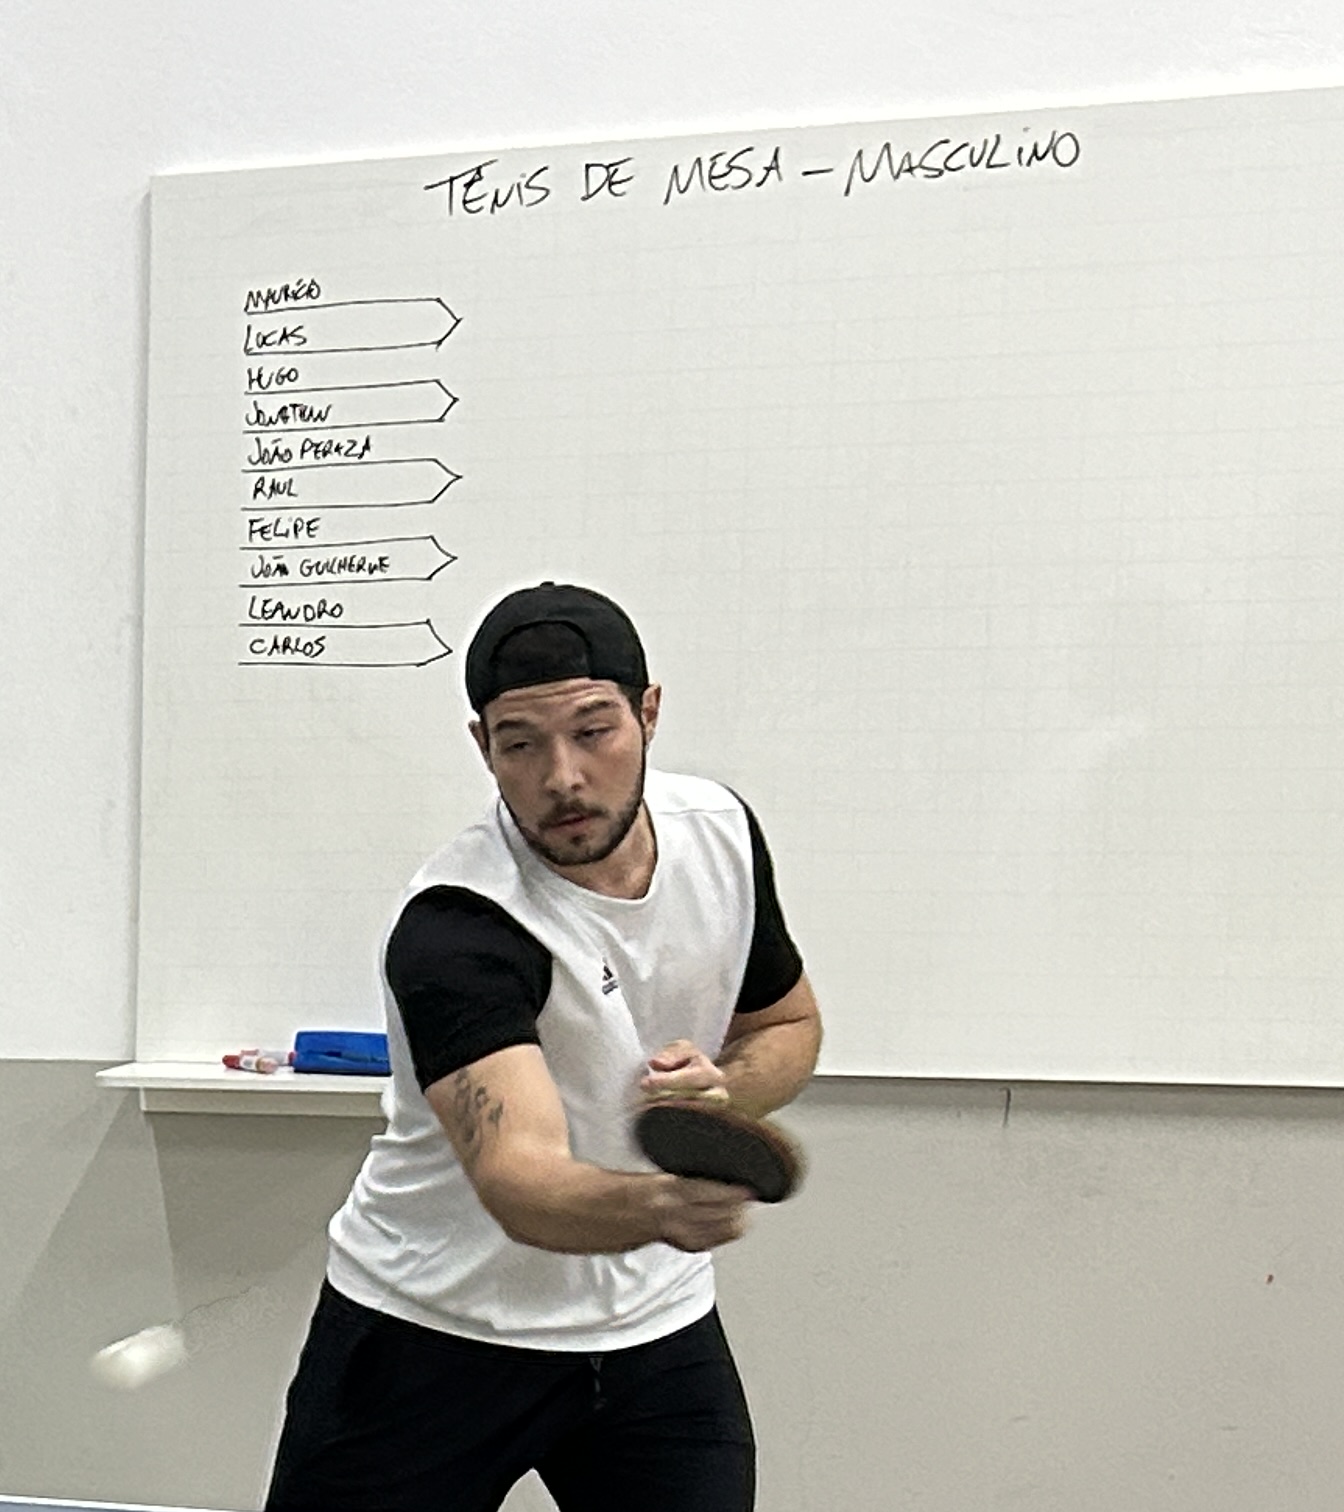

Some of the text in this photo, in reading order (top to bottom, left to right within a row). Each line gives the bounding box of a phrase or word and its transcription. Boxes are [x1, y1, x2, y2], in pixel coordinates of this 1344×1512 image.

[580, 156, 635, 202] DE
[662, 145, 784, 206] MESA
[843, 126, 1081, 197] MASCULINO
[243, 323, 308, 352] LUCAS
[246, 366, 300, 391] HUGO
[252, 475, 299, 501] RAUL
[248, 516, 322, 543] FELIPE
[247, 594, 344, 623] LEANDRO
[248, 634, 327, 659] CARLOS
